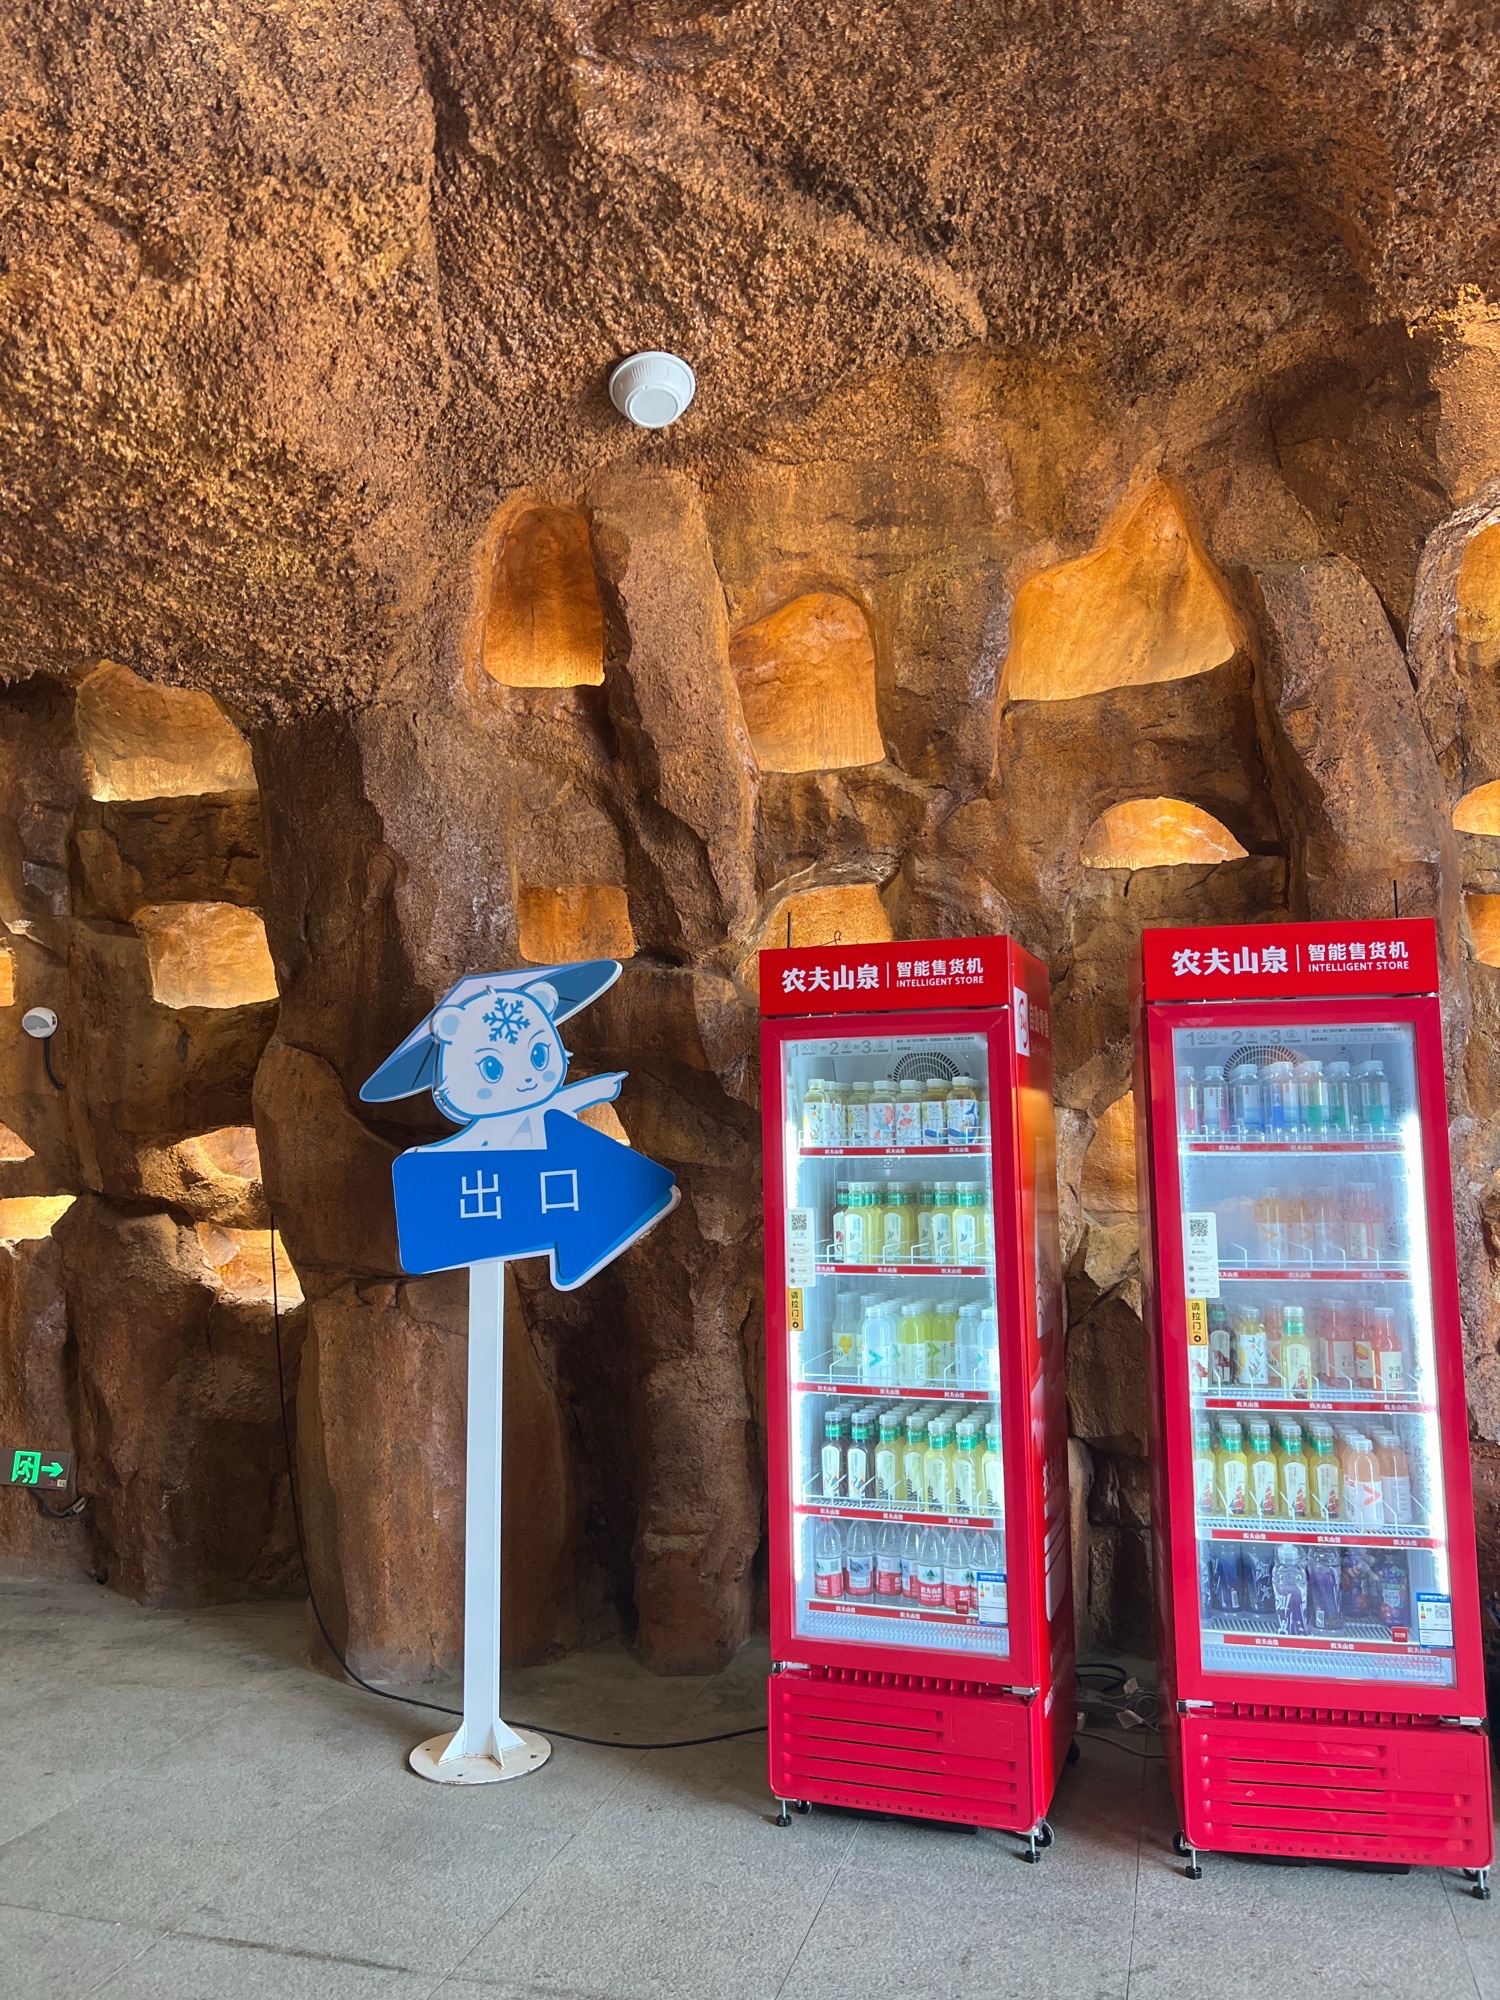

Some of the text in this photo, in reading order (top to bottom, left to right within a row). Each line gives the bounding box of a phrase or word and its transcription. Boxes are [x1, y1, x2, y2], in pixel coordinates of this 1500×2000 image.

[1171, 945, 1289, 977] 农夫山泉
[1308, 941, 1409, 962] 智能售货机
[896, 957, 984, 977] 智能售货机
[1308, 960, 1409, 973] INTELLIGENT STORE
[781, 963, 880, 993] 农夫山泉
[896, 975, 984, 988] INTELLIGENT STORE
[1186, 1029, 1282, 1046] 1 2 3
[791, 1040, 871, 1057] 1 2 3
[459, 1168, 579, 1220] 出口
[1191, 1302, 1202, 1331] 请拉门
